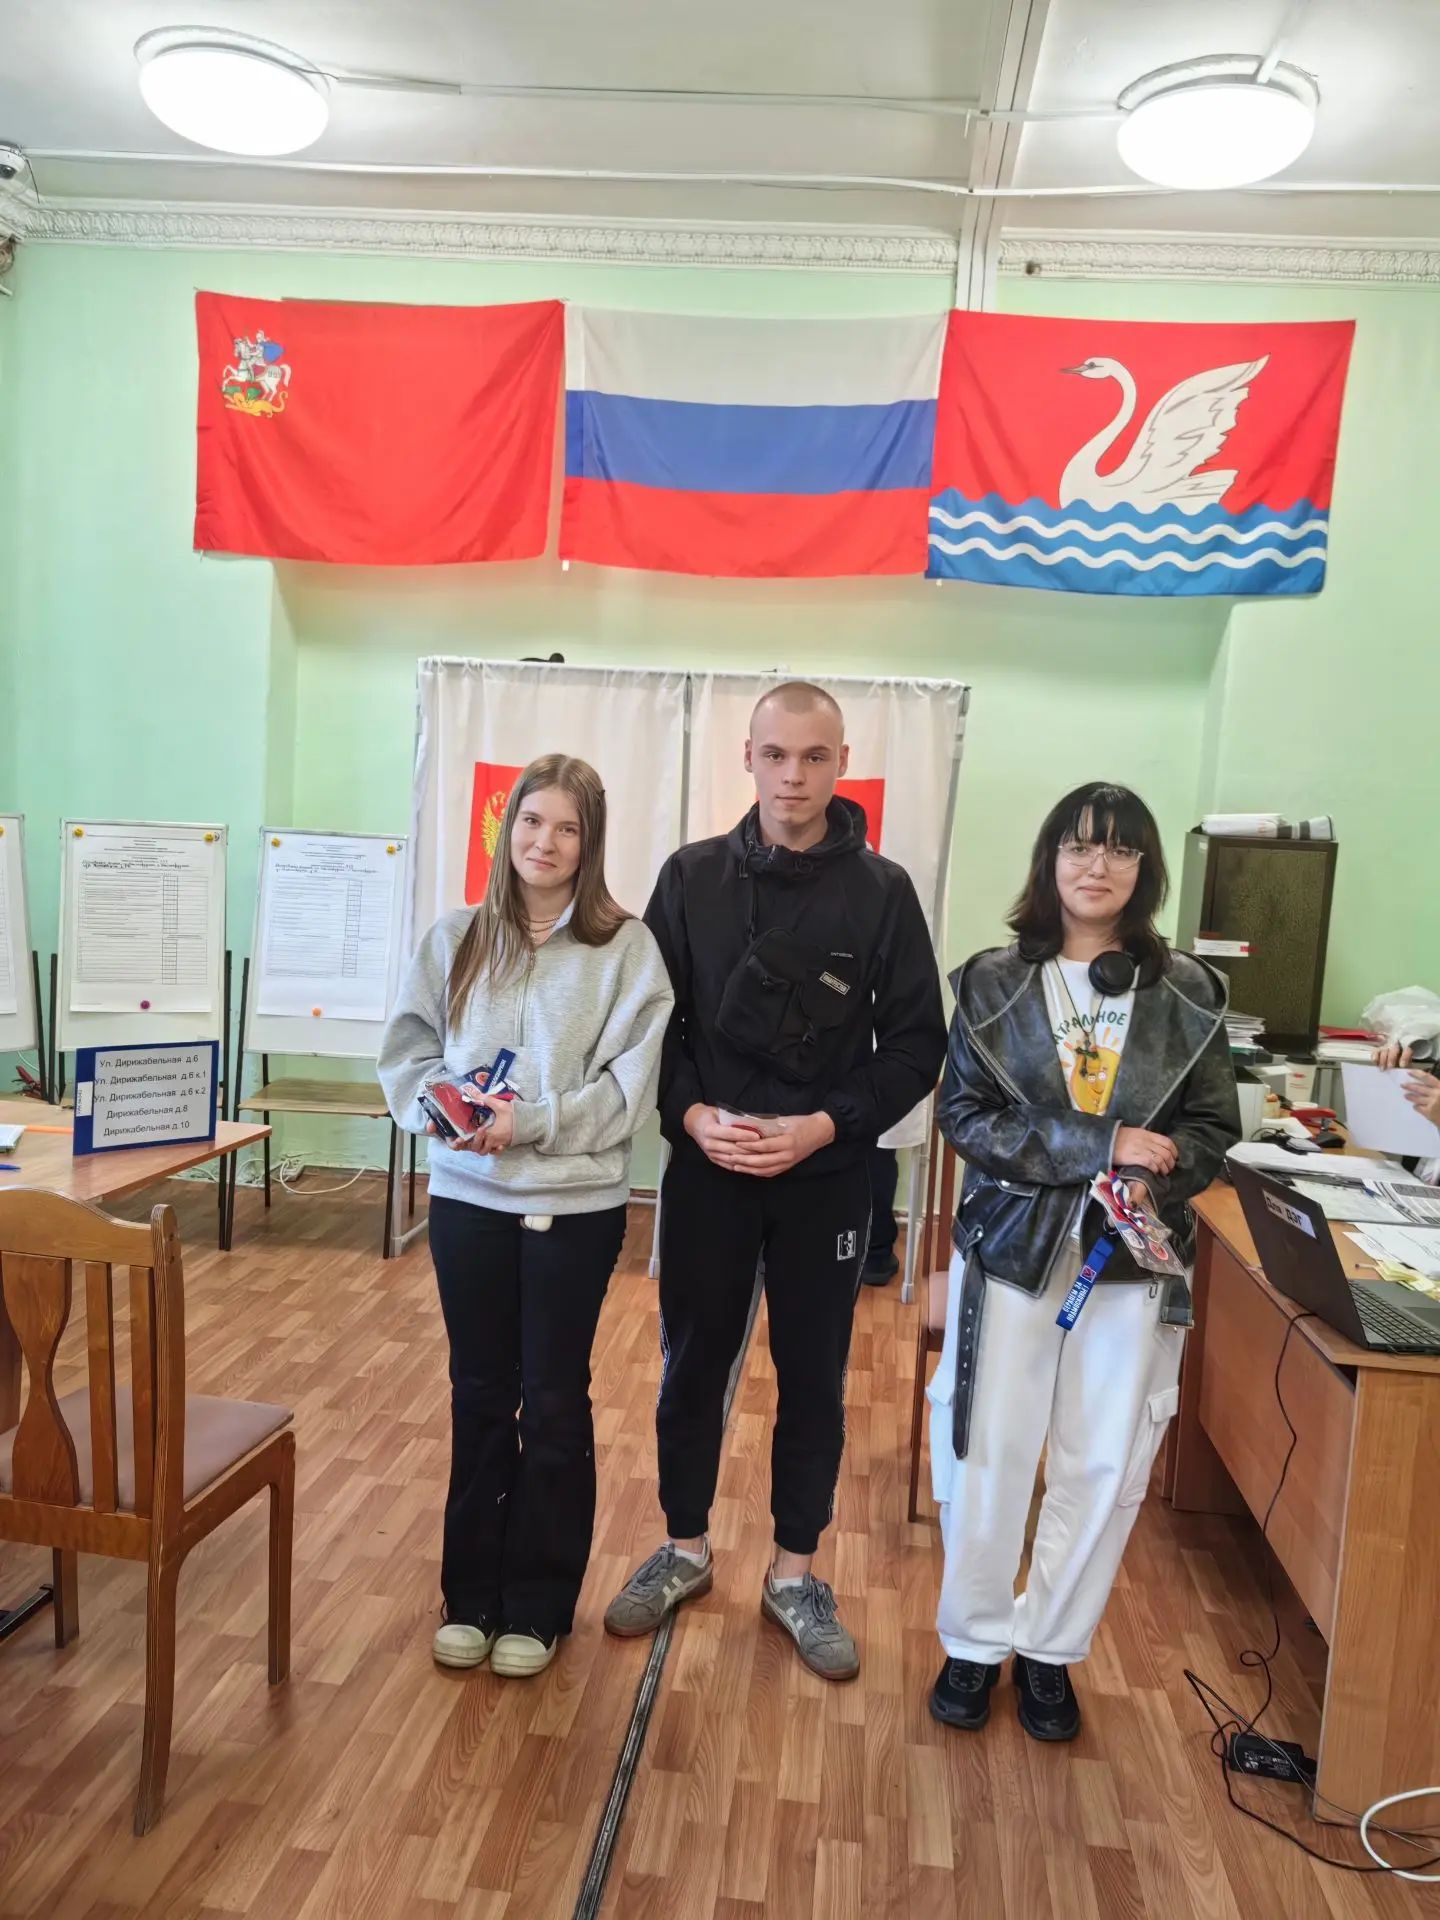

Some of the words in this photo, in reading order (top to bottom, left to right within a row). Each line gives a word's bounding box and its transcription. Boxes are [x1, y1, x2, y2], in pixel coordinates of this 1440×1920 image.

[1053, 1010, 1128, 1045] АТРАЛЬНОЕ
[100, 1060, 112, 1068] Ул.
[115, 1056, 182, 1068] Дирижабельная
[110, 1073, 177, 1085] Дирижабельная
[109, 1090, 176, 1102] Дирижабельная
[106, 1107, 173, 1120] Дирижабельная
[103, 1123, 170, 1136] Дирижабельная
